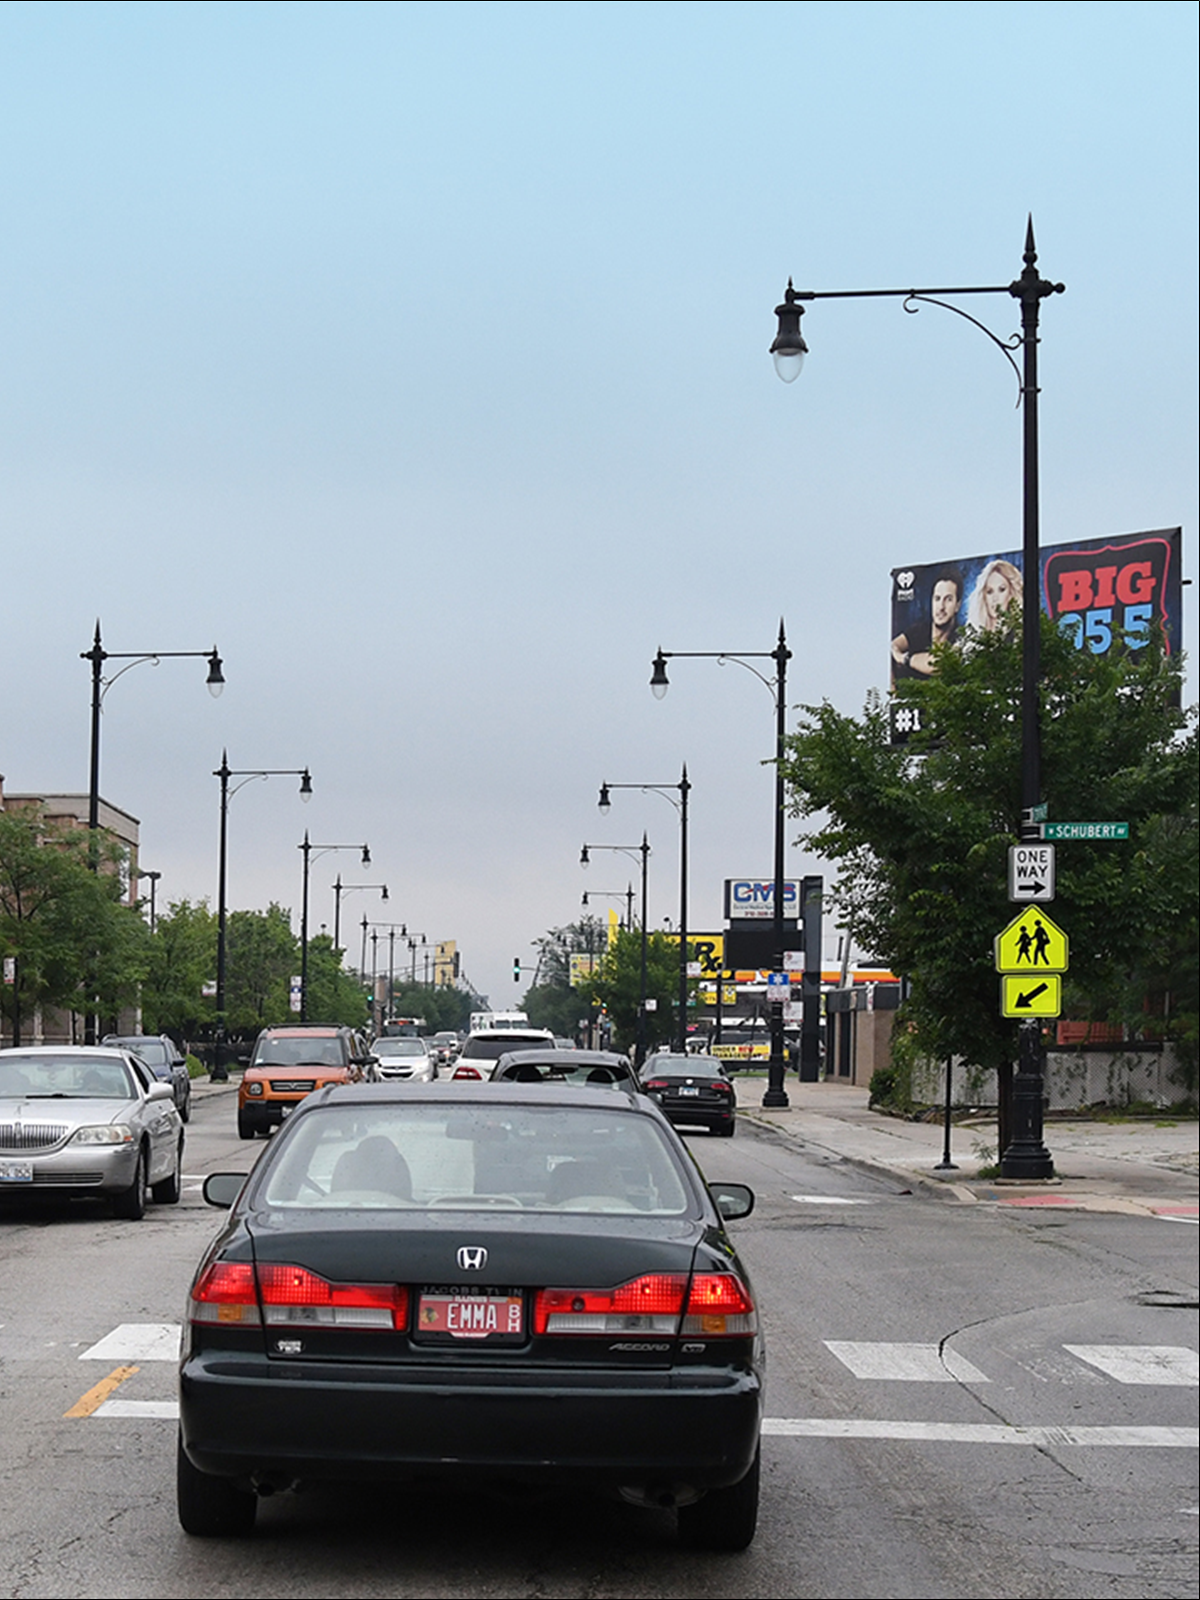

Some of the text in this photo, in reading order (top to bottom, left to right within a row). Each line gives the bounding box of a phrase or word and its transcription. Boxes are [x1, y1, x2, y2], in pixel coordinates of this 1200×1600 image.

[1057, 561, 1156, 612] BIG
[895, 708, 921, 733] #1
[1055, 825, 1116, 838] SCHUBERT
[1016, 850, 1048, 863] ONE
[1016, 865, 1048, 878] WAY
[733, 882, 797, 902] CMS
[447, 1303, 497, 1329] EMMA
[609, 1343, 671, 1351] ACCORD
